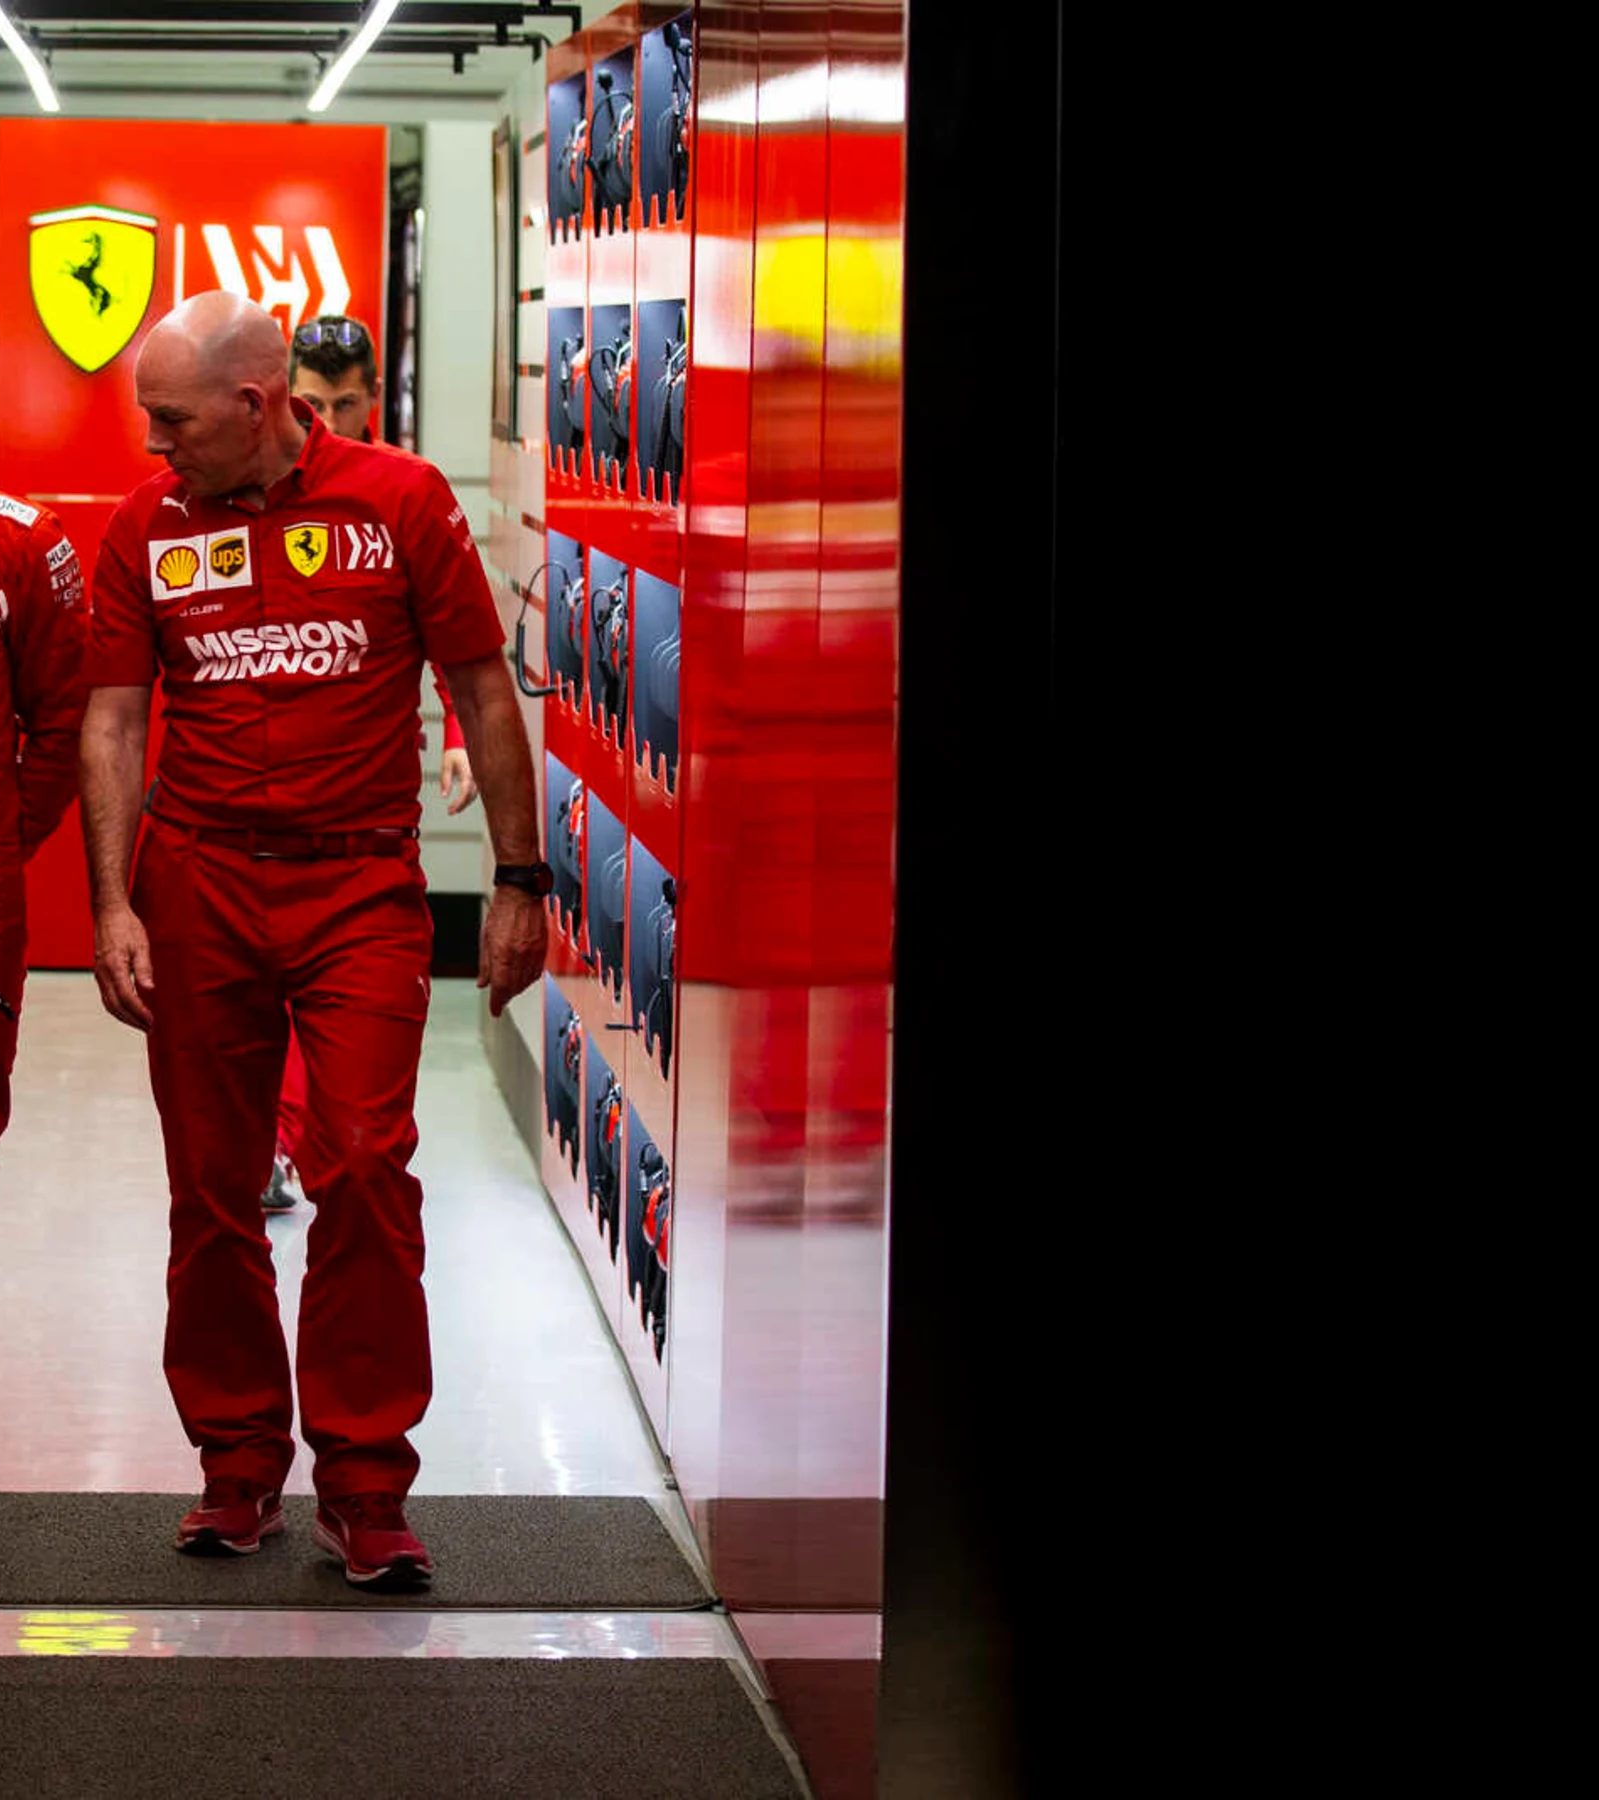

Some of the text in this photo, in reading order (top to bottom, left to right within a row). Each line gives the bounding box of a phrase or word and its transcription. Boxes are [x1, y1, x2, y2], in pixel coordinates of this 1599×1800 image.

[213, 548, 245, 573] ups
[184, 618, 370, 661] MISSION
[192, 646, 370, 683] WINNOW
